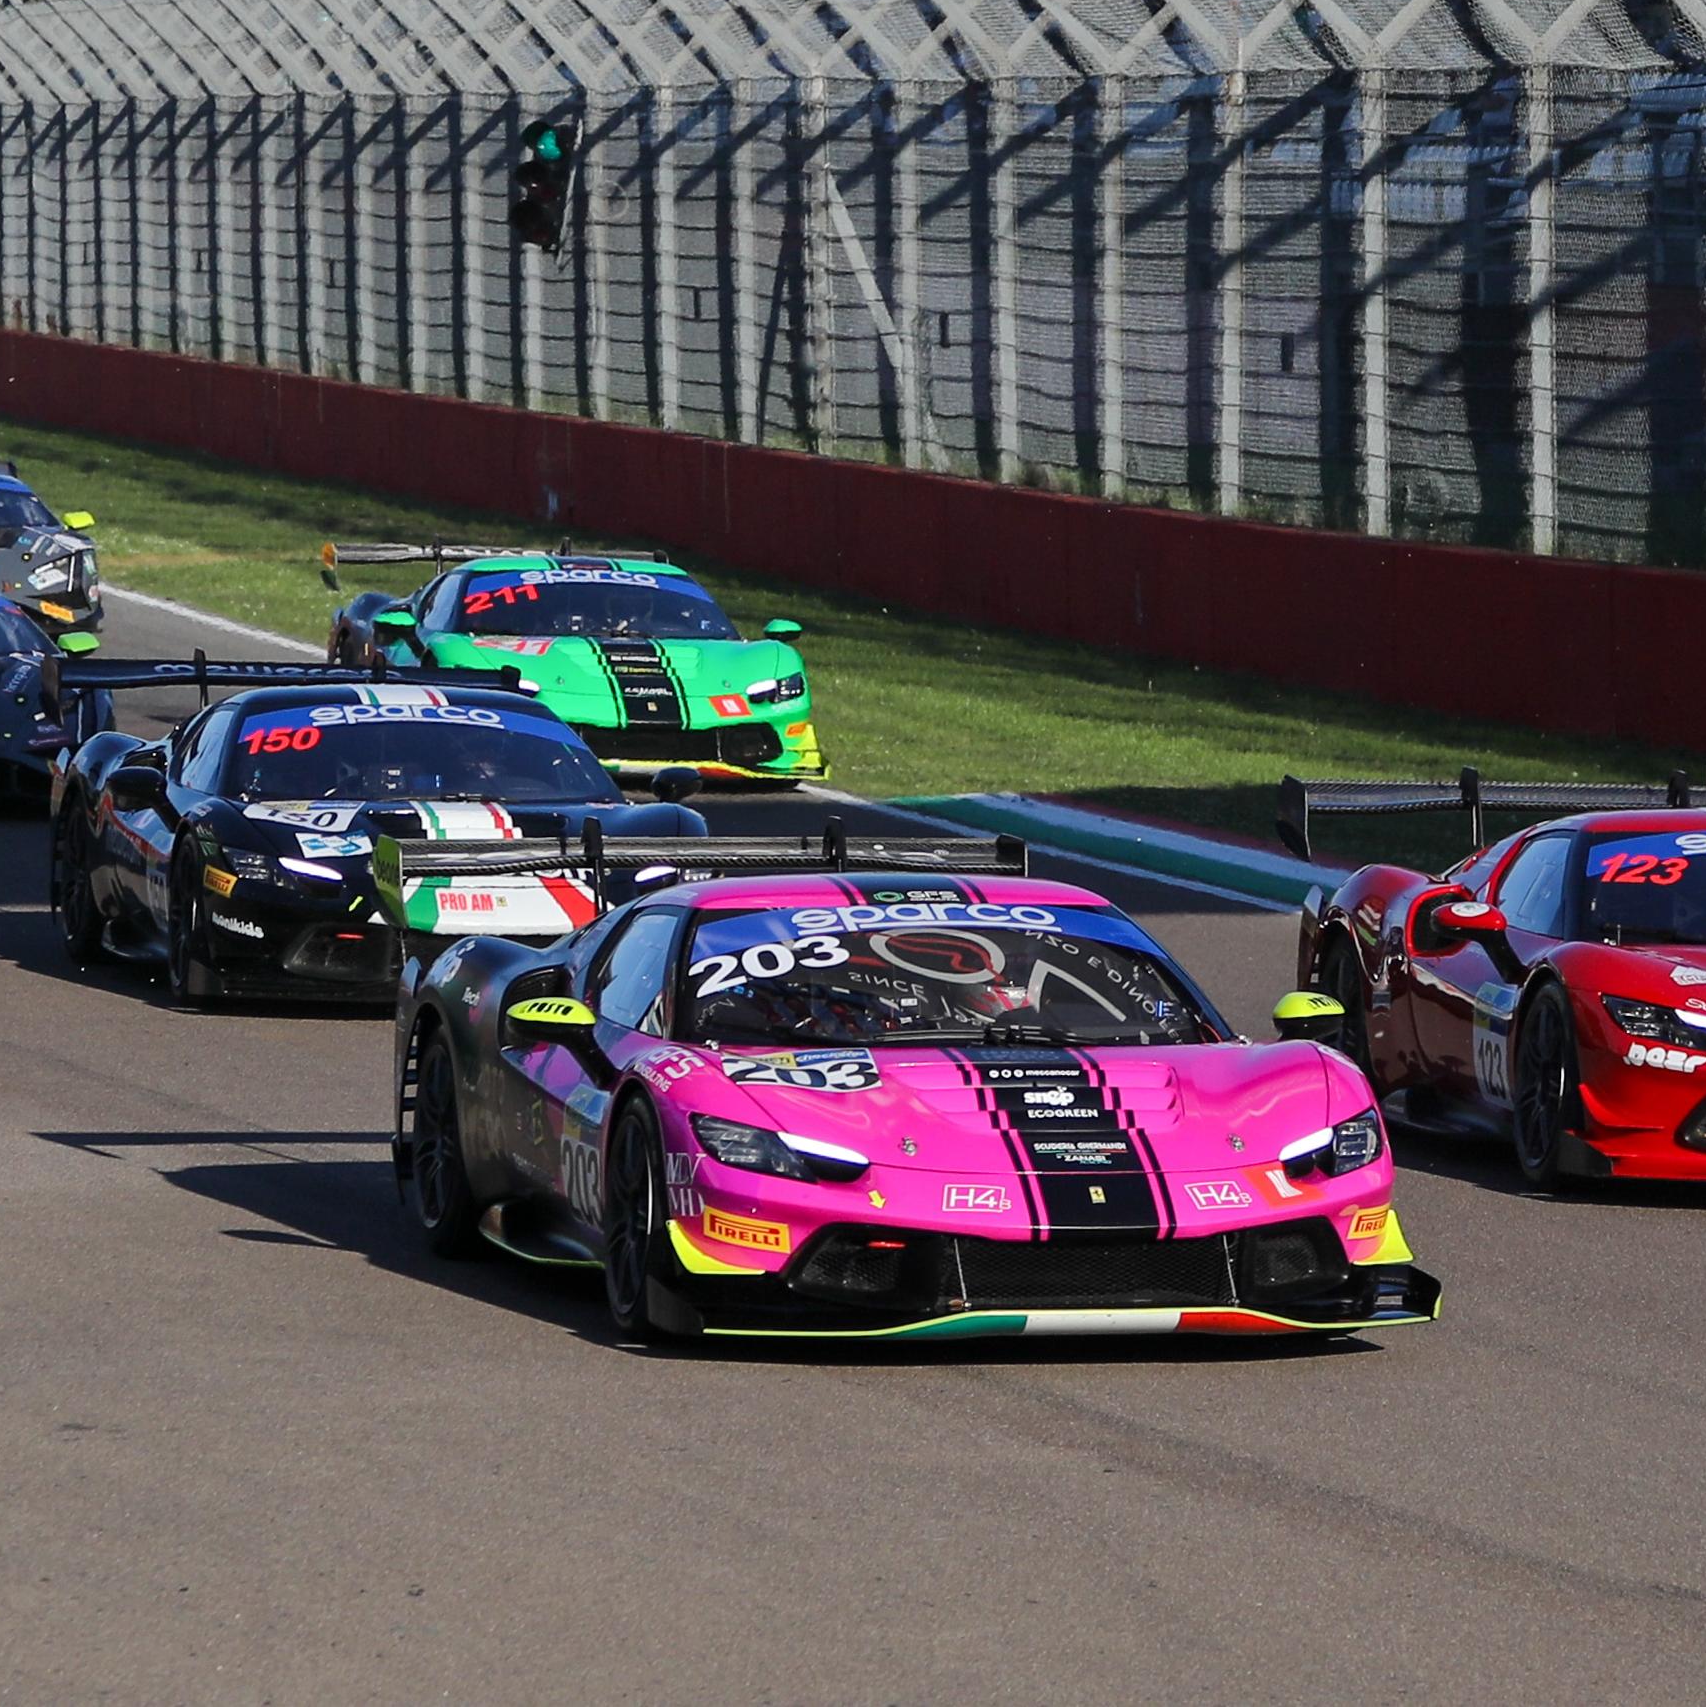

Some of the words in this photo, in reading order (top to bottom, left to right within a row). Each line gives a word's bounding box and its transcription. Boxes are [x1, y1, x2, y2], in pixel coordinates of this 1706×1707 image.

[519, 569, 657, 585] sparco
[462, 583, 540, 615] 211
[309, 704, 500, 725] sparco
[244, 727, 323, 756] 150
[1599, 852, 1691, 886] 123
[440, 892, 468, 911] PRO
[470, 893, 494, 911] AM
[791, 902, 1057, 933] sparco
[687, 934, 850, 999] 203
[462, 986, 480, 1006] Tech
[723, 1058, 882, 1091] 203
[1478, 1038, 1507, 1100] 123
[1027, 1108, 1099, 1119] ECOGREEN
[1033, 1141, 1077, 1151] SCUDERIA
[561, 1139, 603, 1226] 203
[709, 1215, 781, 1247] PIRELLI
